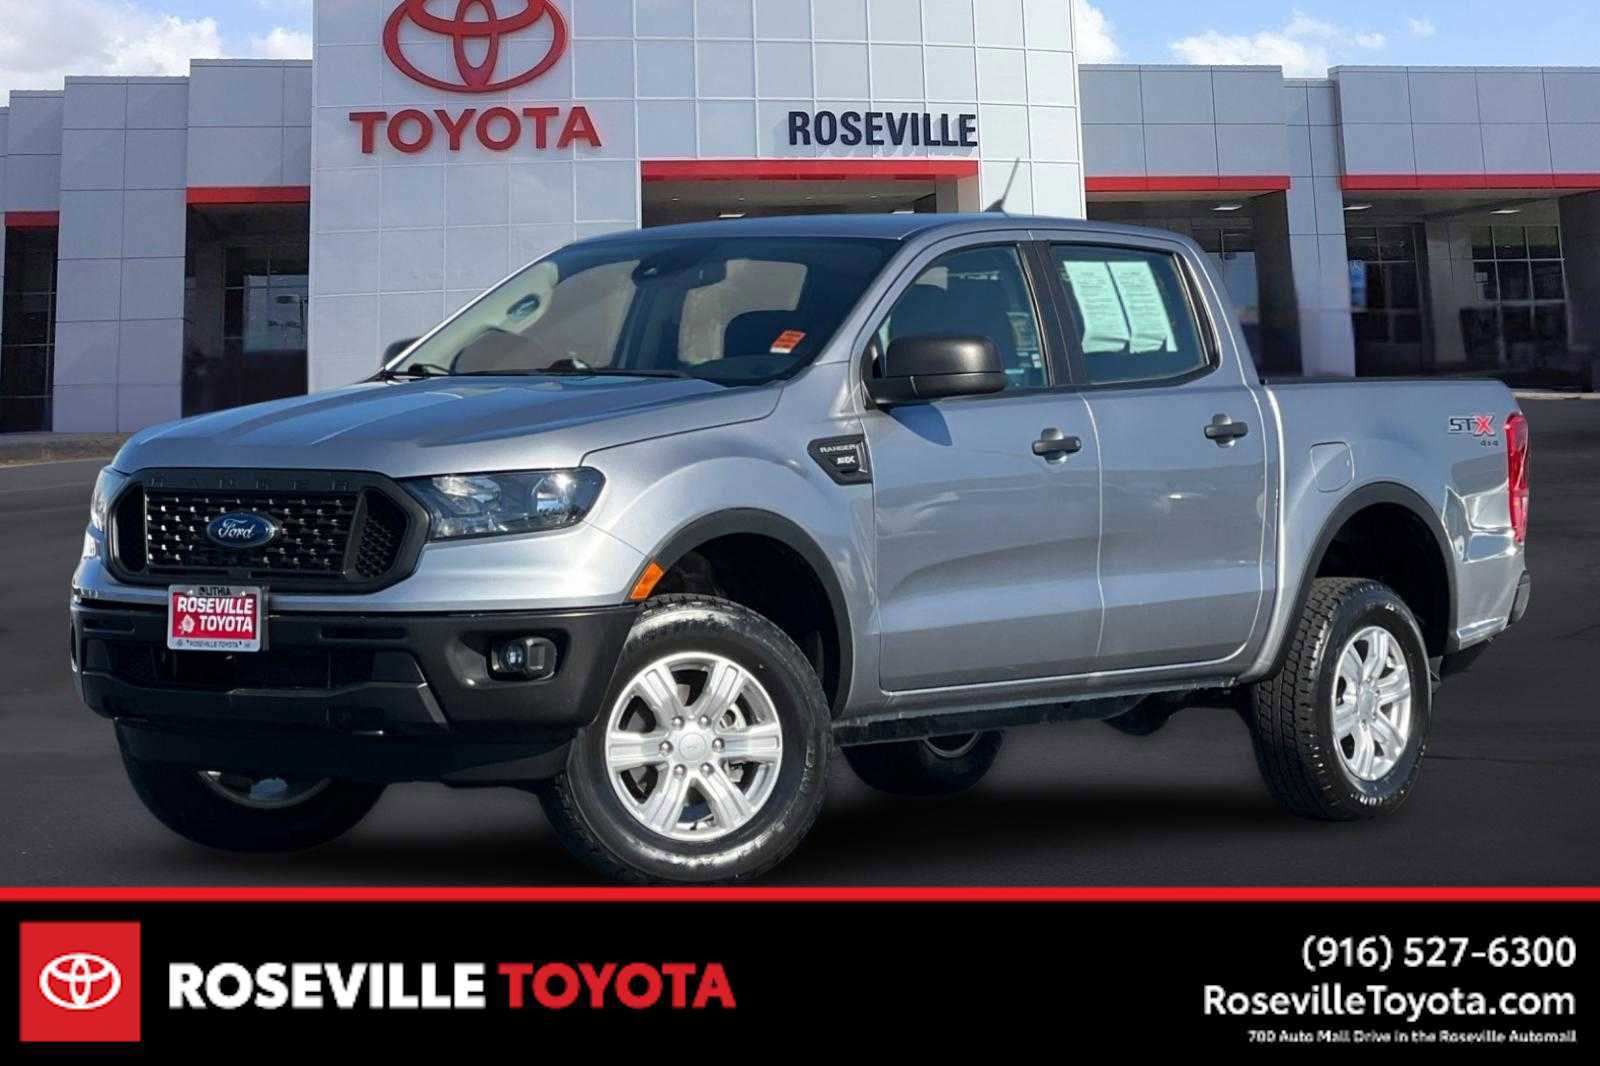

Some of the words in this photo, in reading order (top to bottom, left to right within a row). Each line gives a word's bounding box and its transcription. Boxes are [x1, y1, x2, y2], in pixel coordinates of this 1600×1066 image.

[349, 106, 602, 154] TOYOTA
[788, 110, 978, 147] ROSEVILLE
[1449, 415, 1496, 436] STX
[218, 518, 256, 539] Ford
[177, 597, 253, 614] ROSEVILLE
[199, 615, 252, 632] TOYOTA
